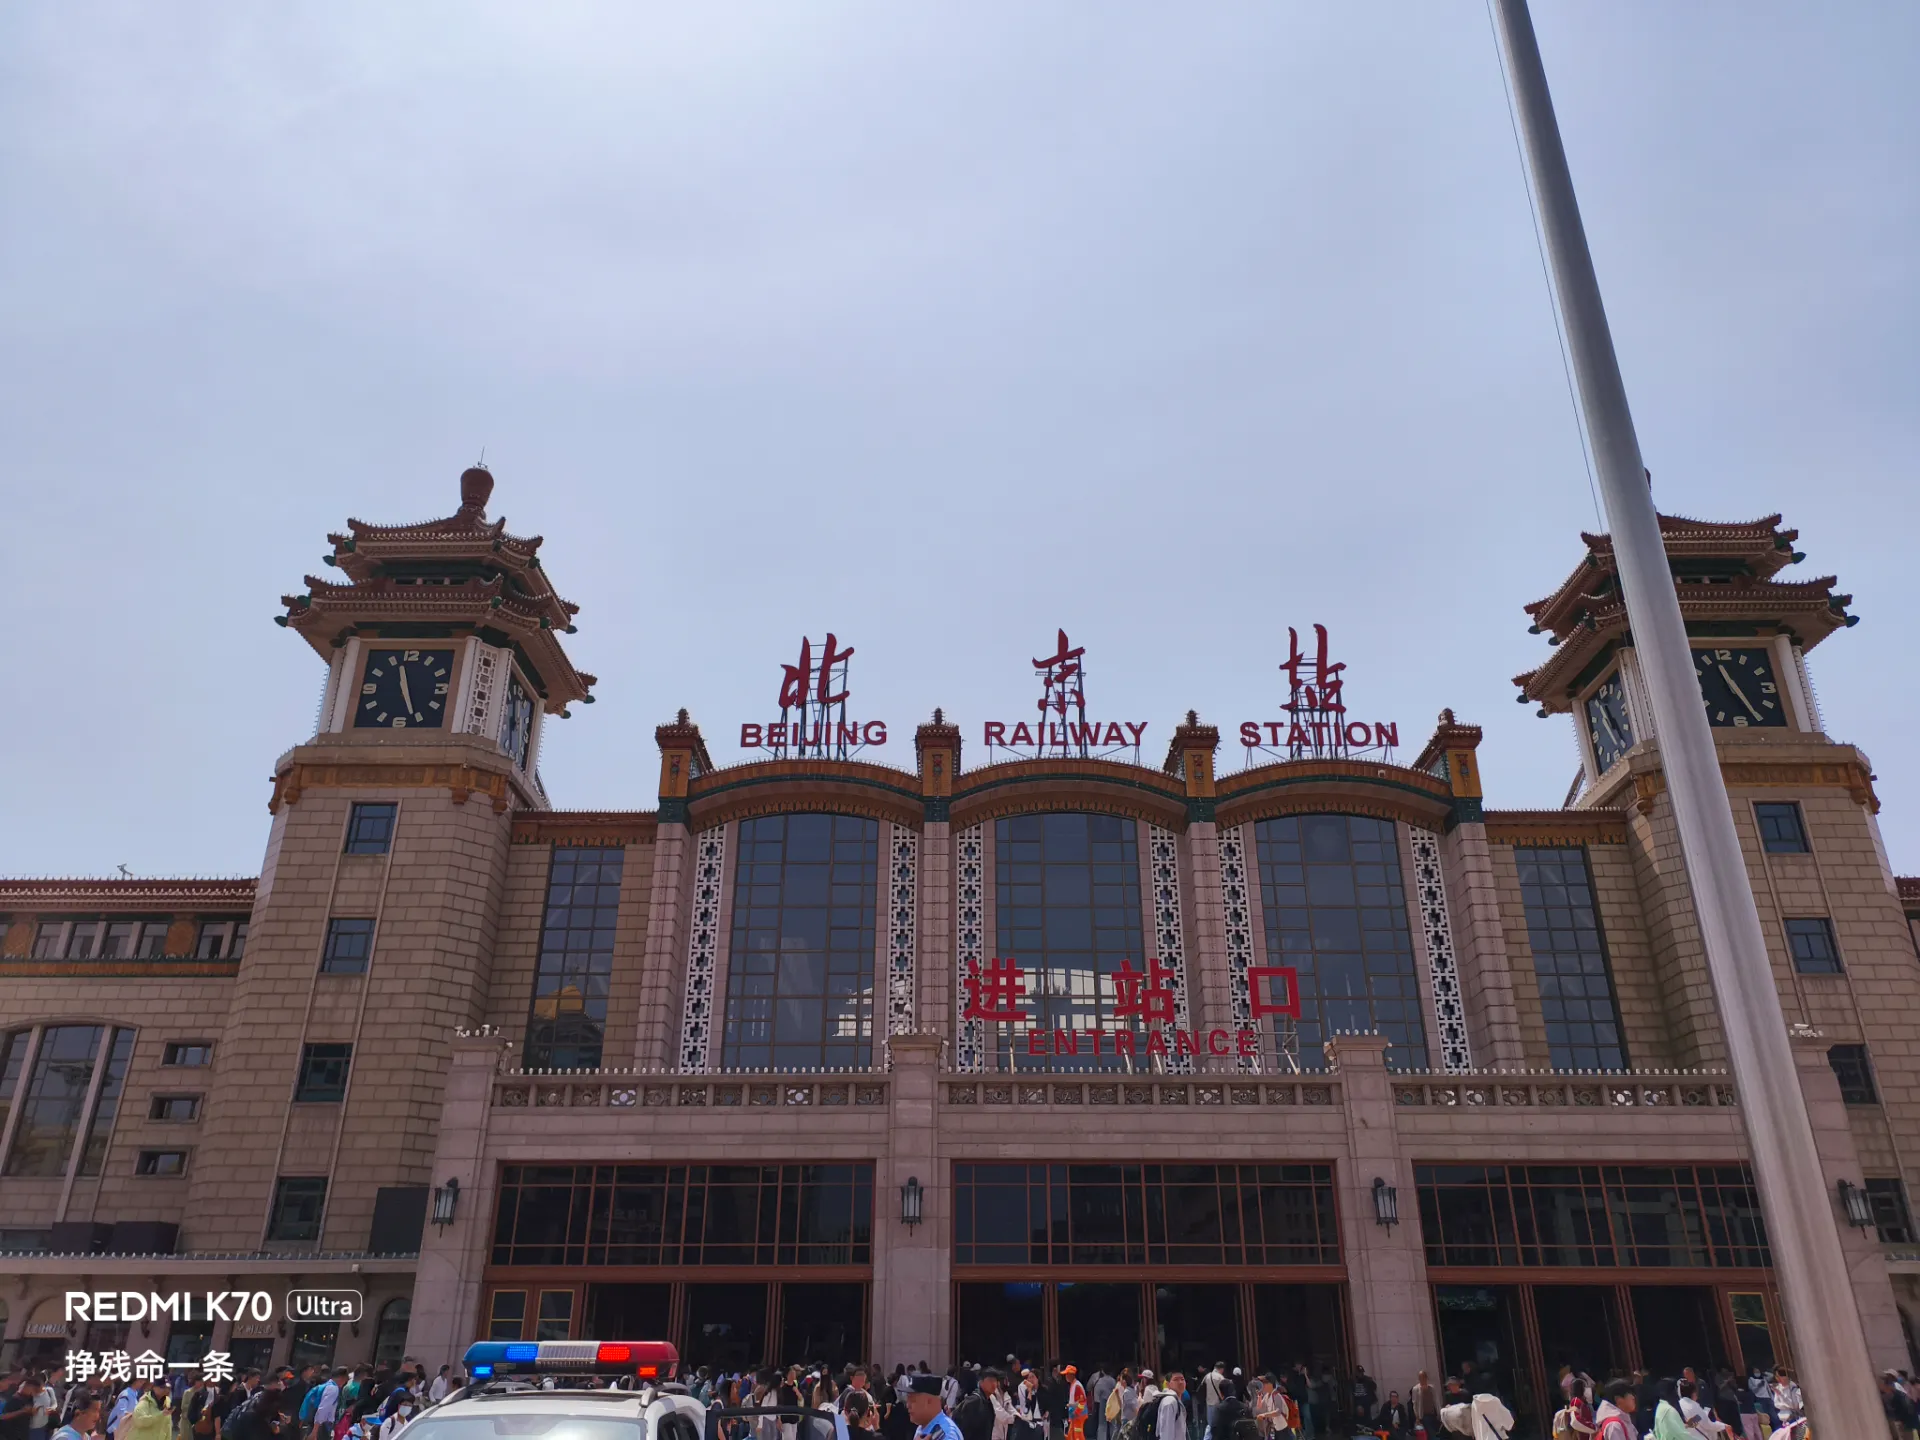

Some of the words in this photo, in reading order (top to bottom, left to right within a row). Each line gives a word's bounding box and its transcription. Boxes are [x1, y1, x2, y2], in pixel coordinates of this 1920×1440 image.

[404, 651, 419, 661] 12
[1714, 650, 1732, 660] 12
[363, 683, 377, 694] 9
[434, 683, 448, 694] 3
[1761, 682, 1776, 693] 3
[393, 717, 407, 728] 6
[1733, 716, 1748, 727] 6
[740, 721, 887, 748] BEIJING
[985, 721, 1148, 747] RAILWAY
[1240, 721, 1399, 748] STATION
[962, 957, 1301, 1024] 进站口
[1028, 1029, 1257, 1056] ENTRANCE
